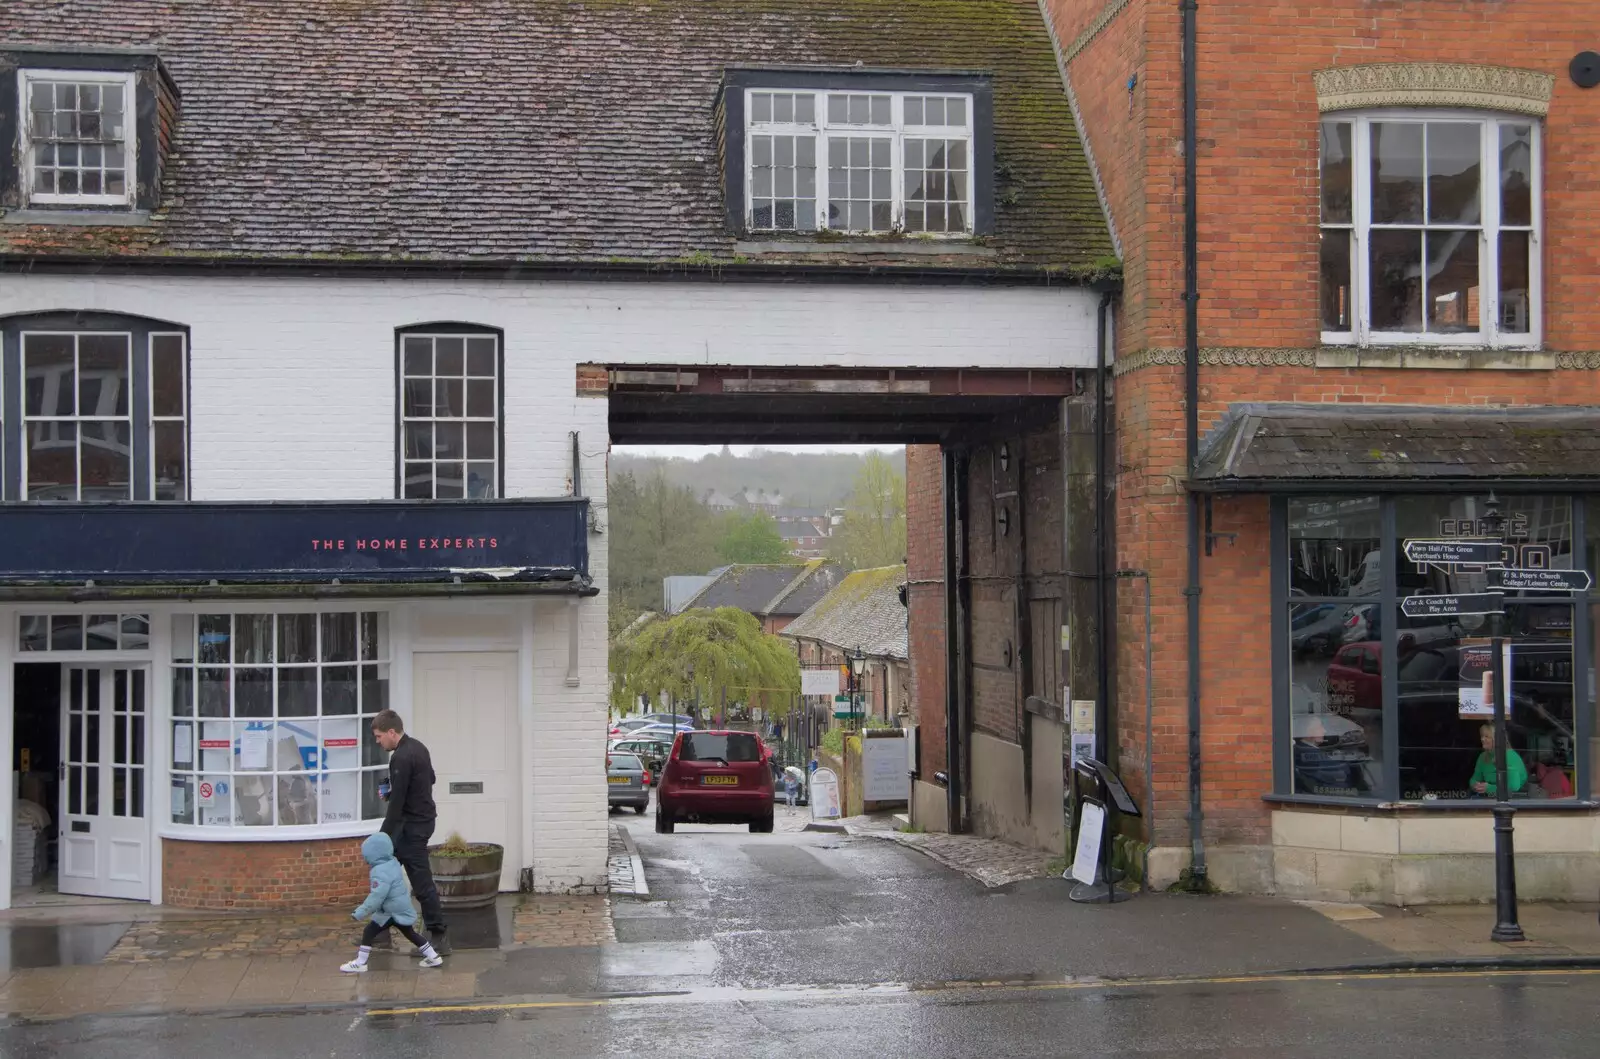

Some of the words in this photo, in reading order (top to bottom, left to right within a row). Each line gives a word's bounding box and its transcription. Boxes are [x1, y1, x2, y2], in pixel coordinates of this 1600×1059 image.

[312, 540, 345, 550] THE
[356, 539, 408, 549] HOME
[419, 538, 498, 549] EXPERTS
[1539, 572, 1560, 580] Church
